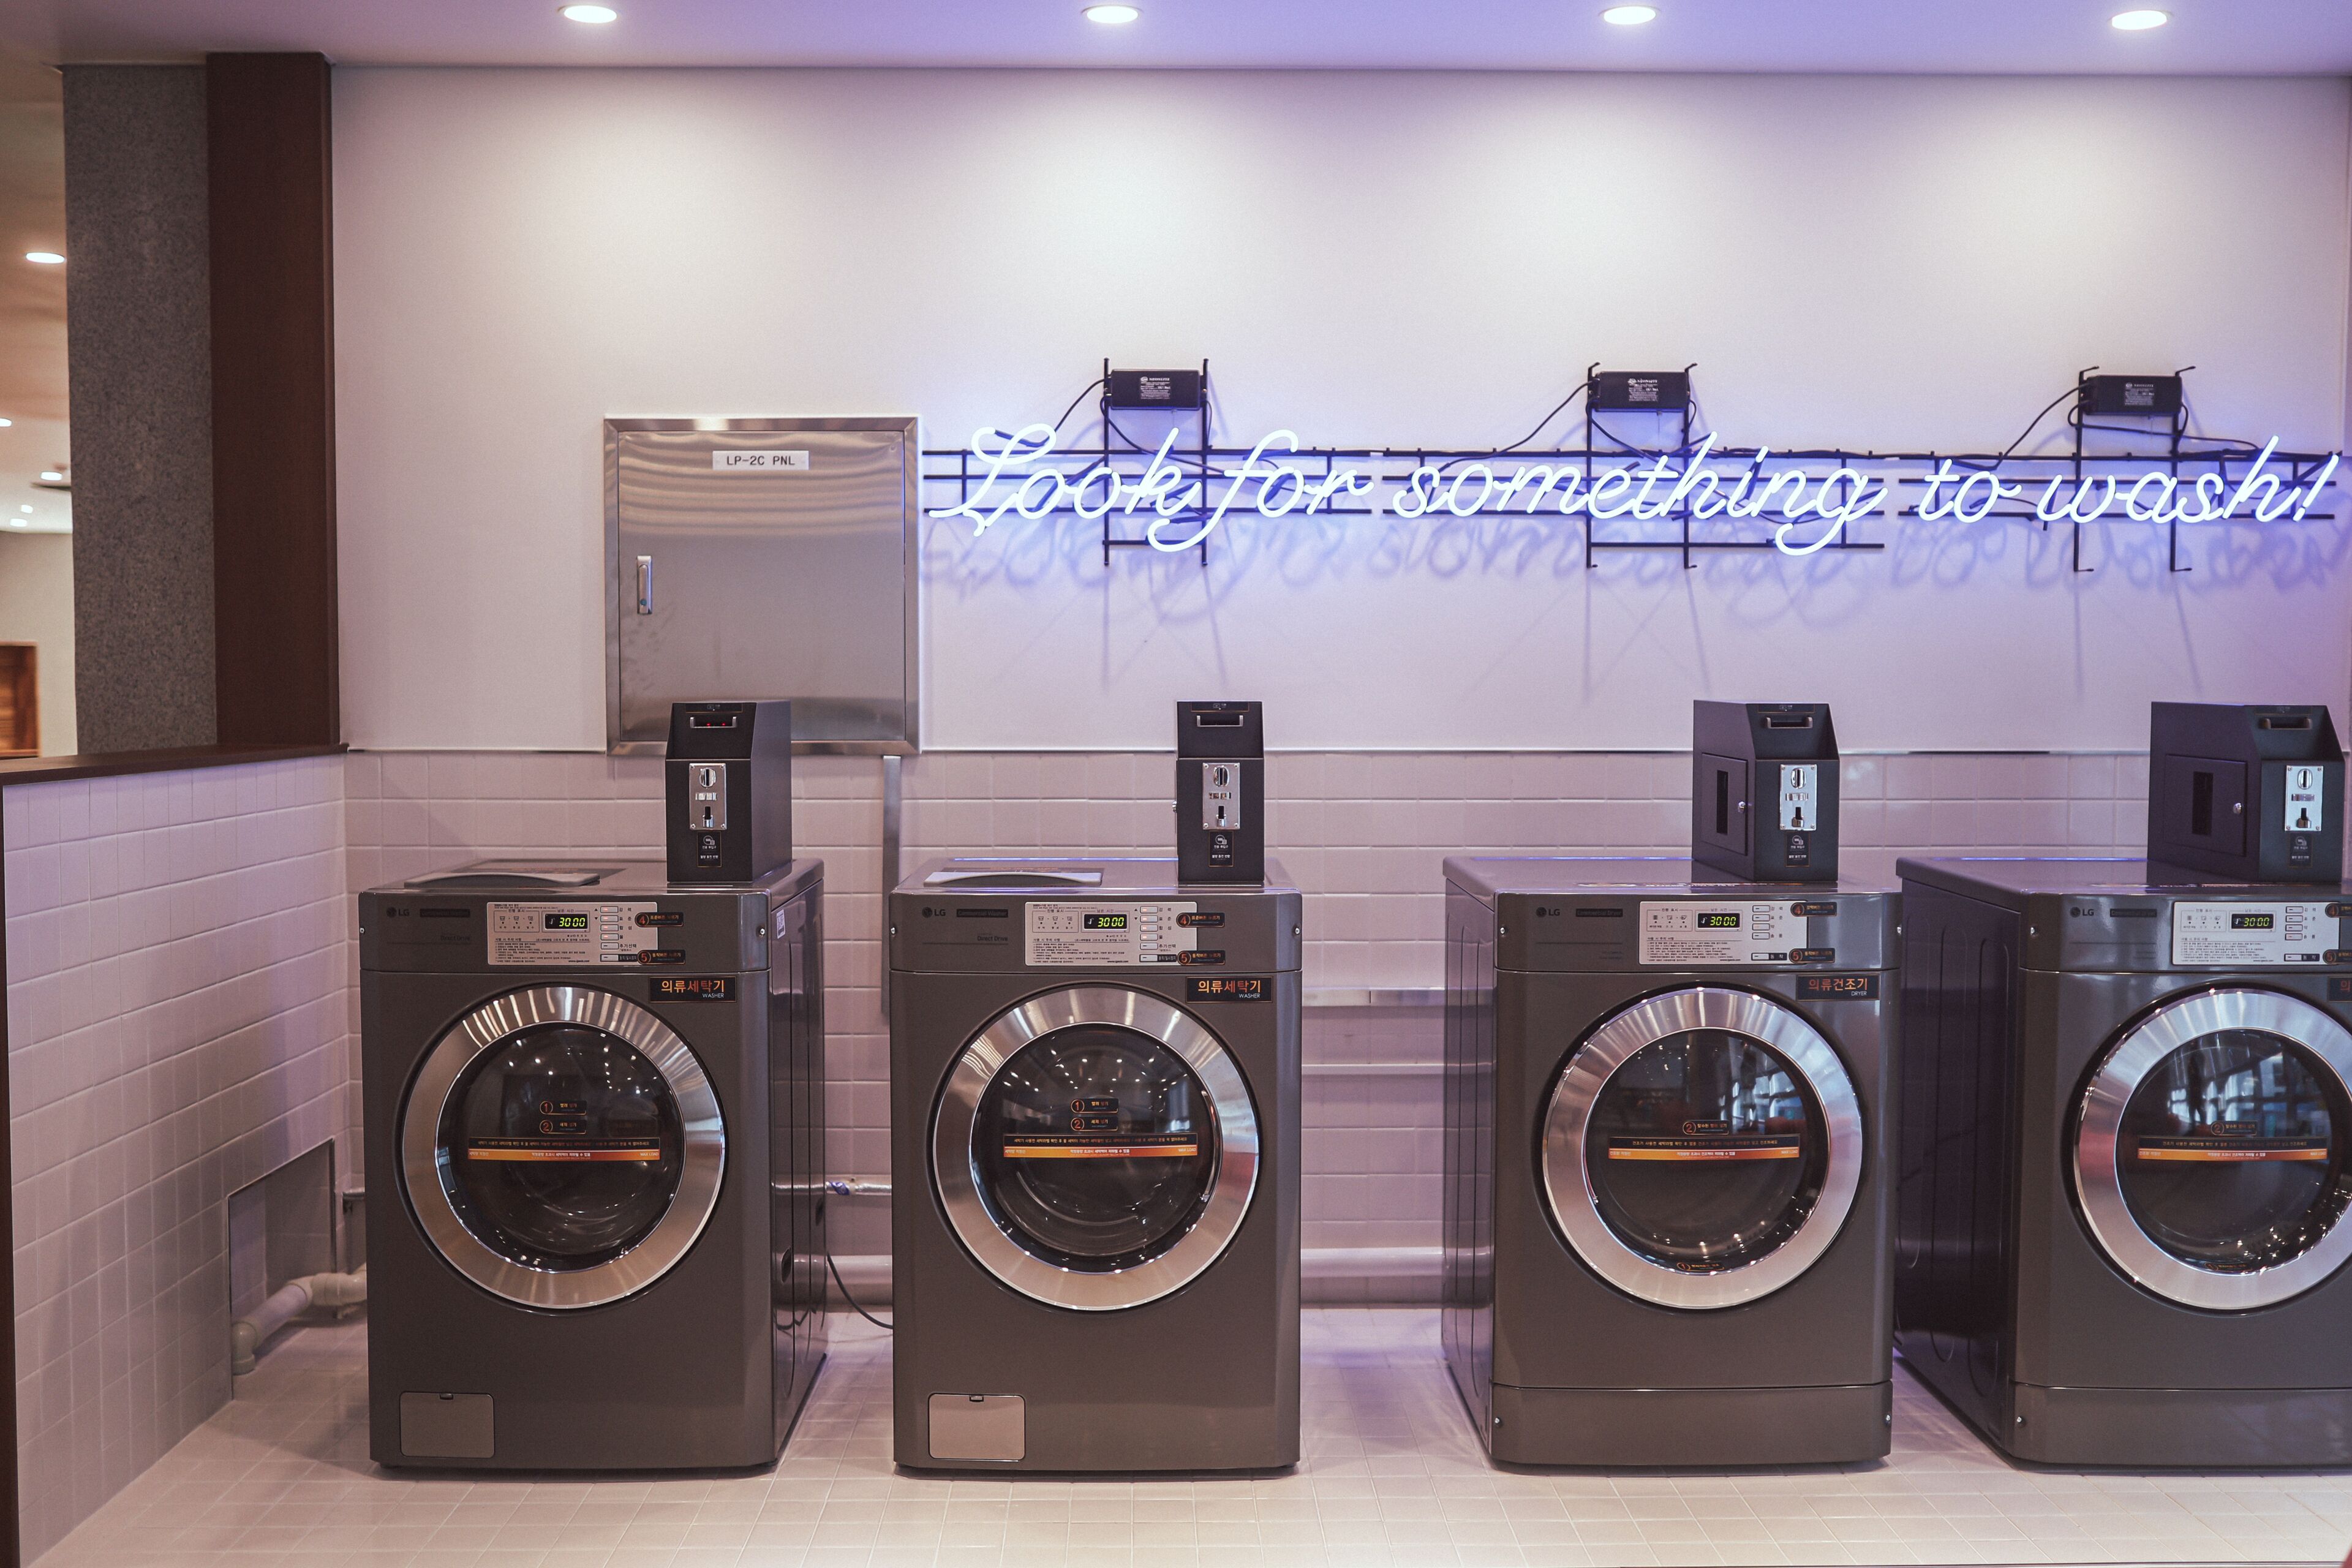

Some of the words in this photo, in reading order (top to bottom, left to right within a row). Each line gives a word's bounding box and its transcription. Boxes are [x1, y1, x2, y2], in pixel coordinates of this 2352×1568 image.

[726, 455, 765, 466] LP-2C
[772, 455, 796, 466] PNL
[929, 423, 1202, 537] Look
[1147, 429, 1374, 552] for
[1392, 431, 1888, 556] something
[1918, 459, 2022, 523] to
[2037, 435, 2340, 522] wash!
[1795, 905, 1801, 914] 4
[559, 917, 586, 927] 3000
[639, 916, 646, 924] 4
[1097, 917, 1125, 927] 3000
[1180, 916, 1186, 924] 4
[1709, 916, 1736, 926] 3000
[2243, 917, 2270, 927] 3000
[641, 953, 647, 962] 5
[1181, 953, 1187, 962] 5
[1793, 952, 1799, 960] 5
[661, 980, 725, 993] 의류세탁기
[1198, 980, 1261, 993] 의류세탁기
[1809, 978, 1868, 991] 의류건조기
